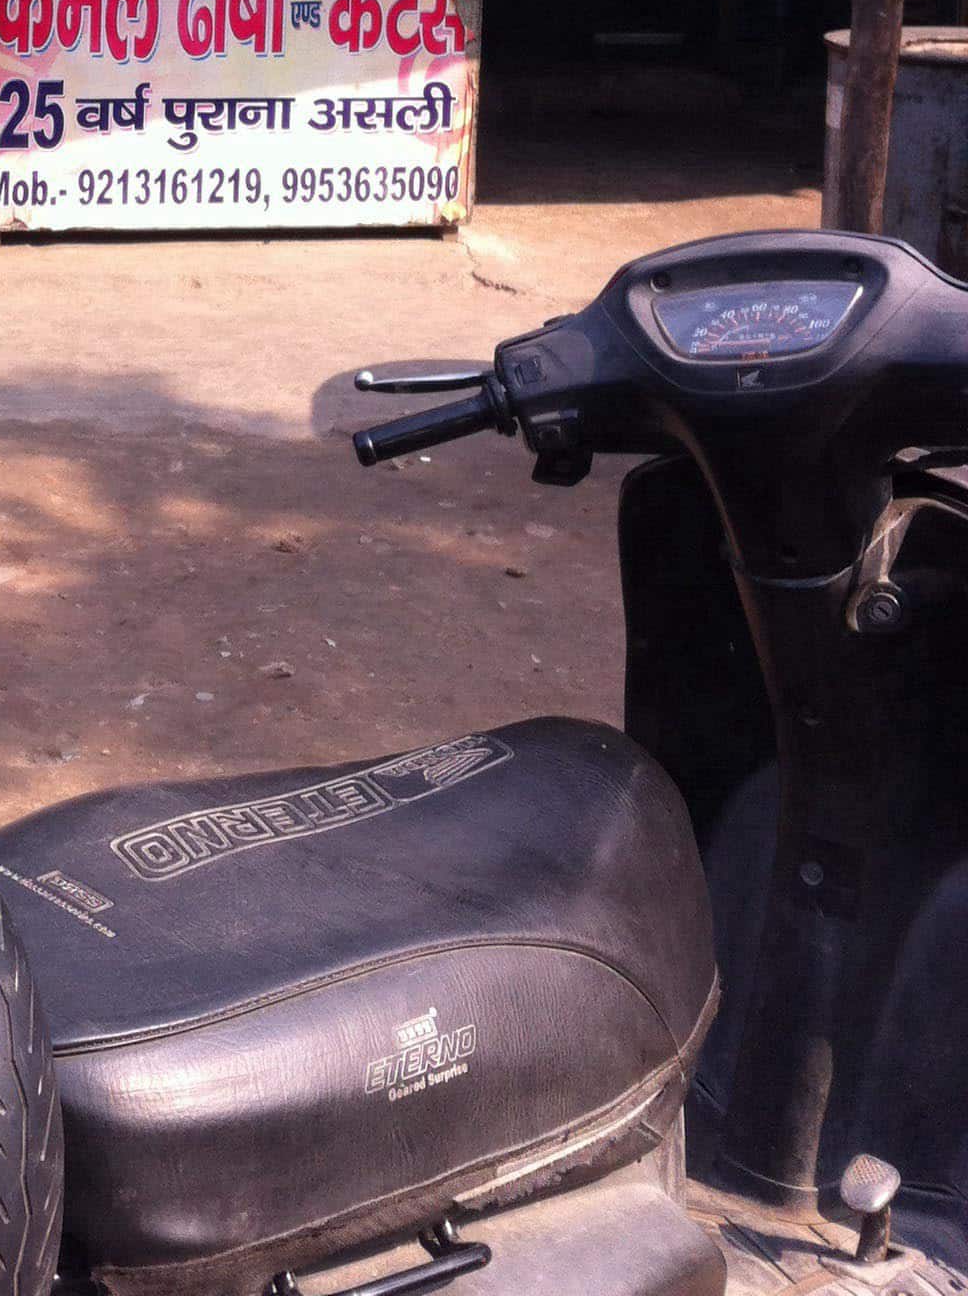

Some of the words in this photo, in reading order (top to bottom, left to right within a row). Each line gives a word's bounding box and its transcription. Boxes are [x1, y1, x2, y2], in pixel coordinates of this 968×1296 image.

[76, 82, 151, 132] वर्ष
[163, 97, 296, 153] पुराना
[308, 81, 457, 132] असली
[282, 165, 460, 204] 9953635090
[123, 779, 384, 874] ETERNO
[365, 1024, 476, 1094] ETERNO
